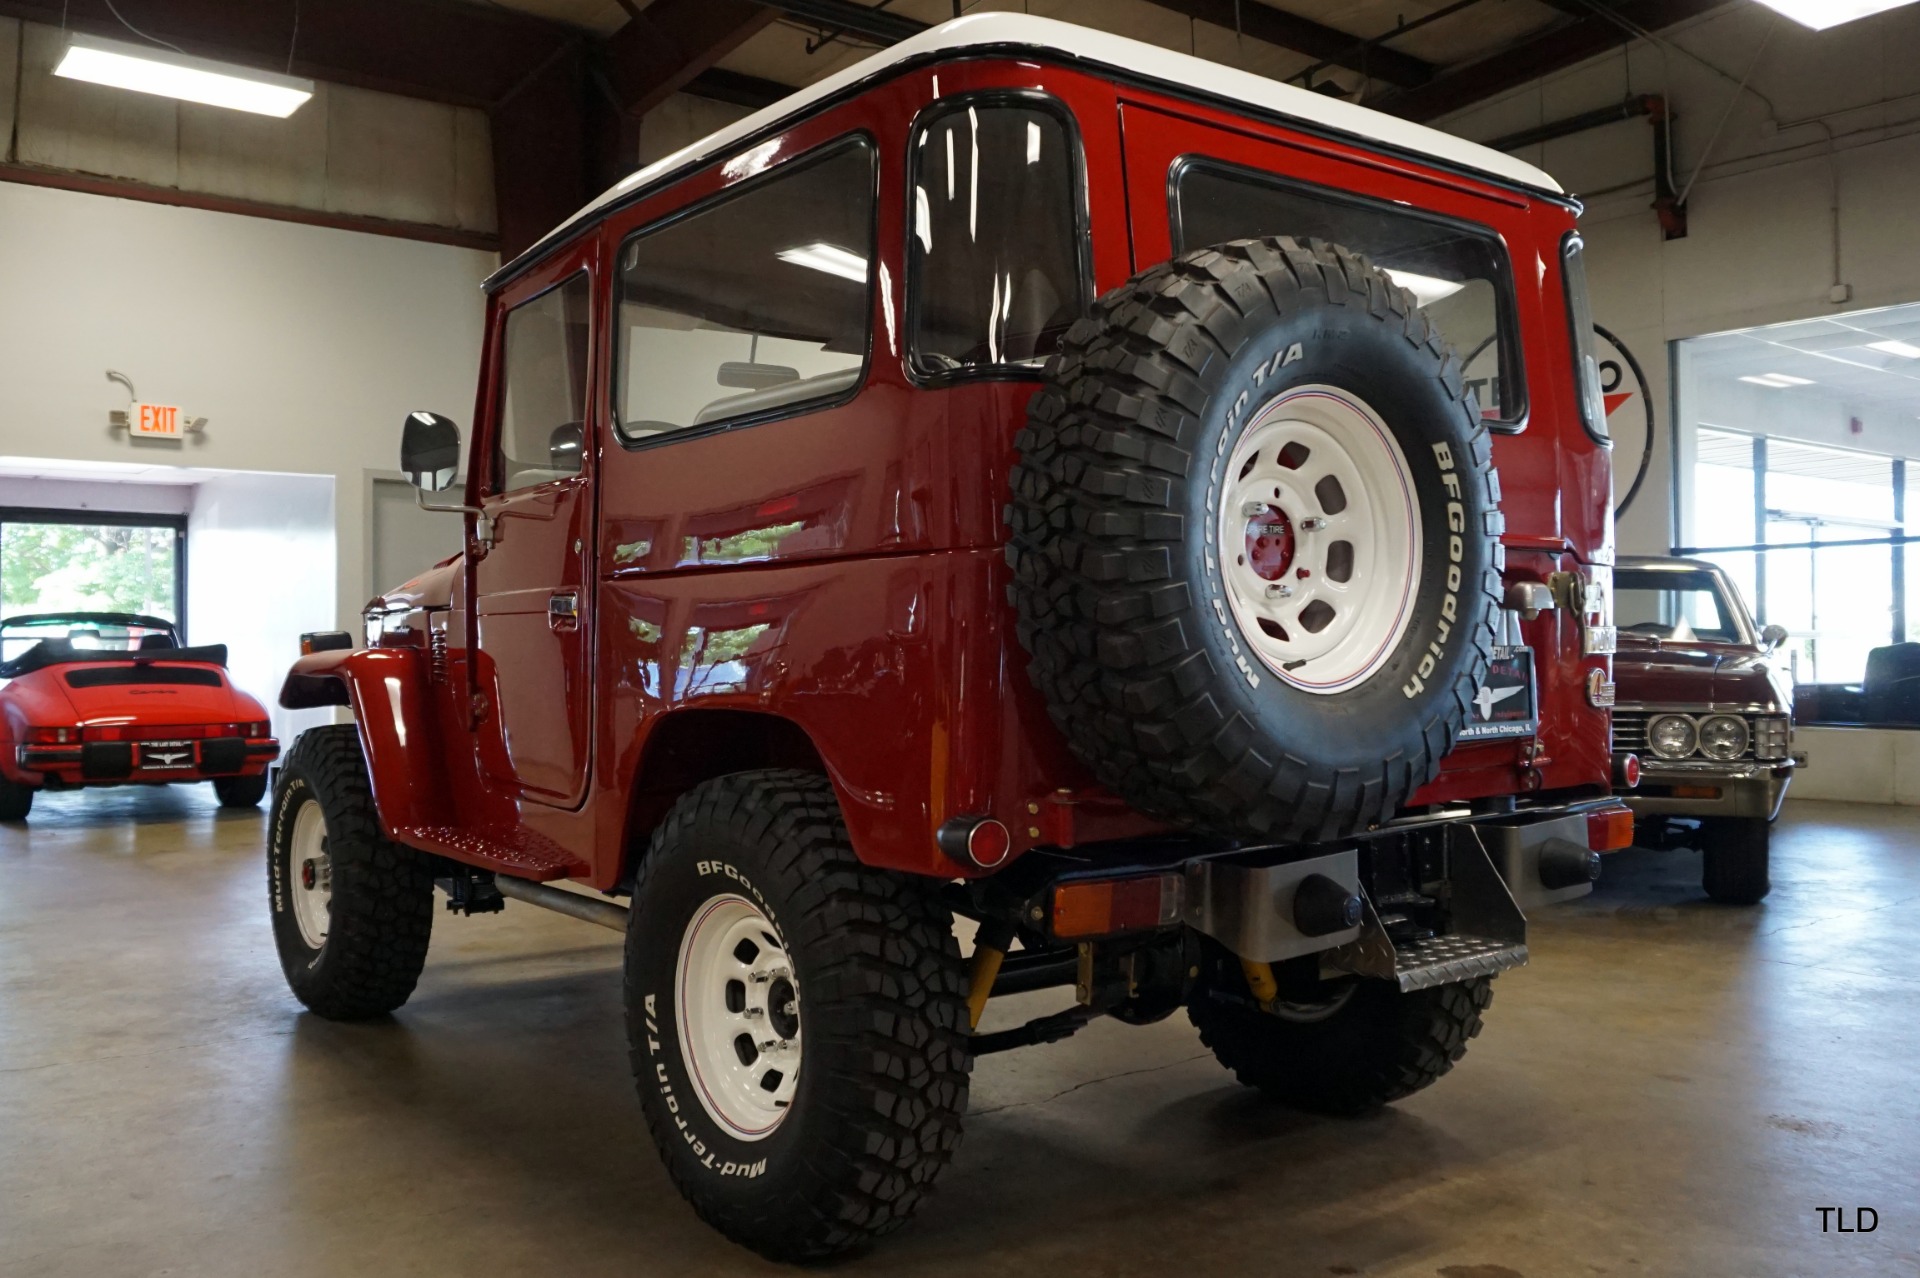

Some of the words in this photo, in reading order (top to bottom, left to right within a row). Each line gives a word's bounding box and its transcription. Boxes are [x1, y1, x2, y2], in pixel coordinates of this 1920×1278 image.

[1252, 342, 1303, 388] T/A
[140, 405, 177, 433] EXIT
[1268, 525, 1285, 534] TIRE
[1402, 441, 1465, 700] BFGoodrich
[1481, 726, 1499, 734] North
[1499, 724, 1525, 734] Chicago,
[1525, 723, 1532, 732] IL
[290, 778, 305, 792] T/A
[644, 993, 661, 1056] T/A
